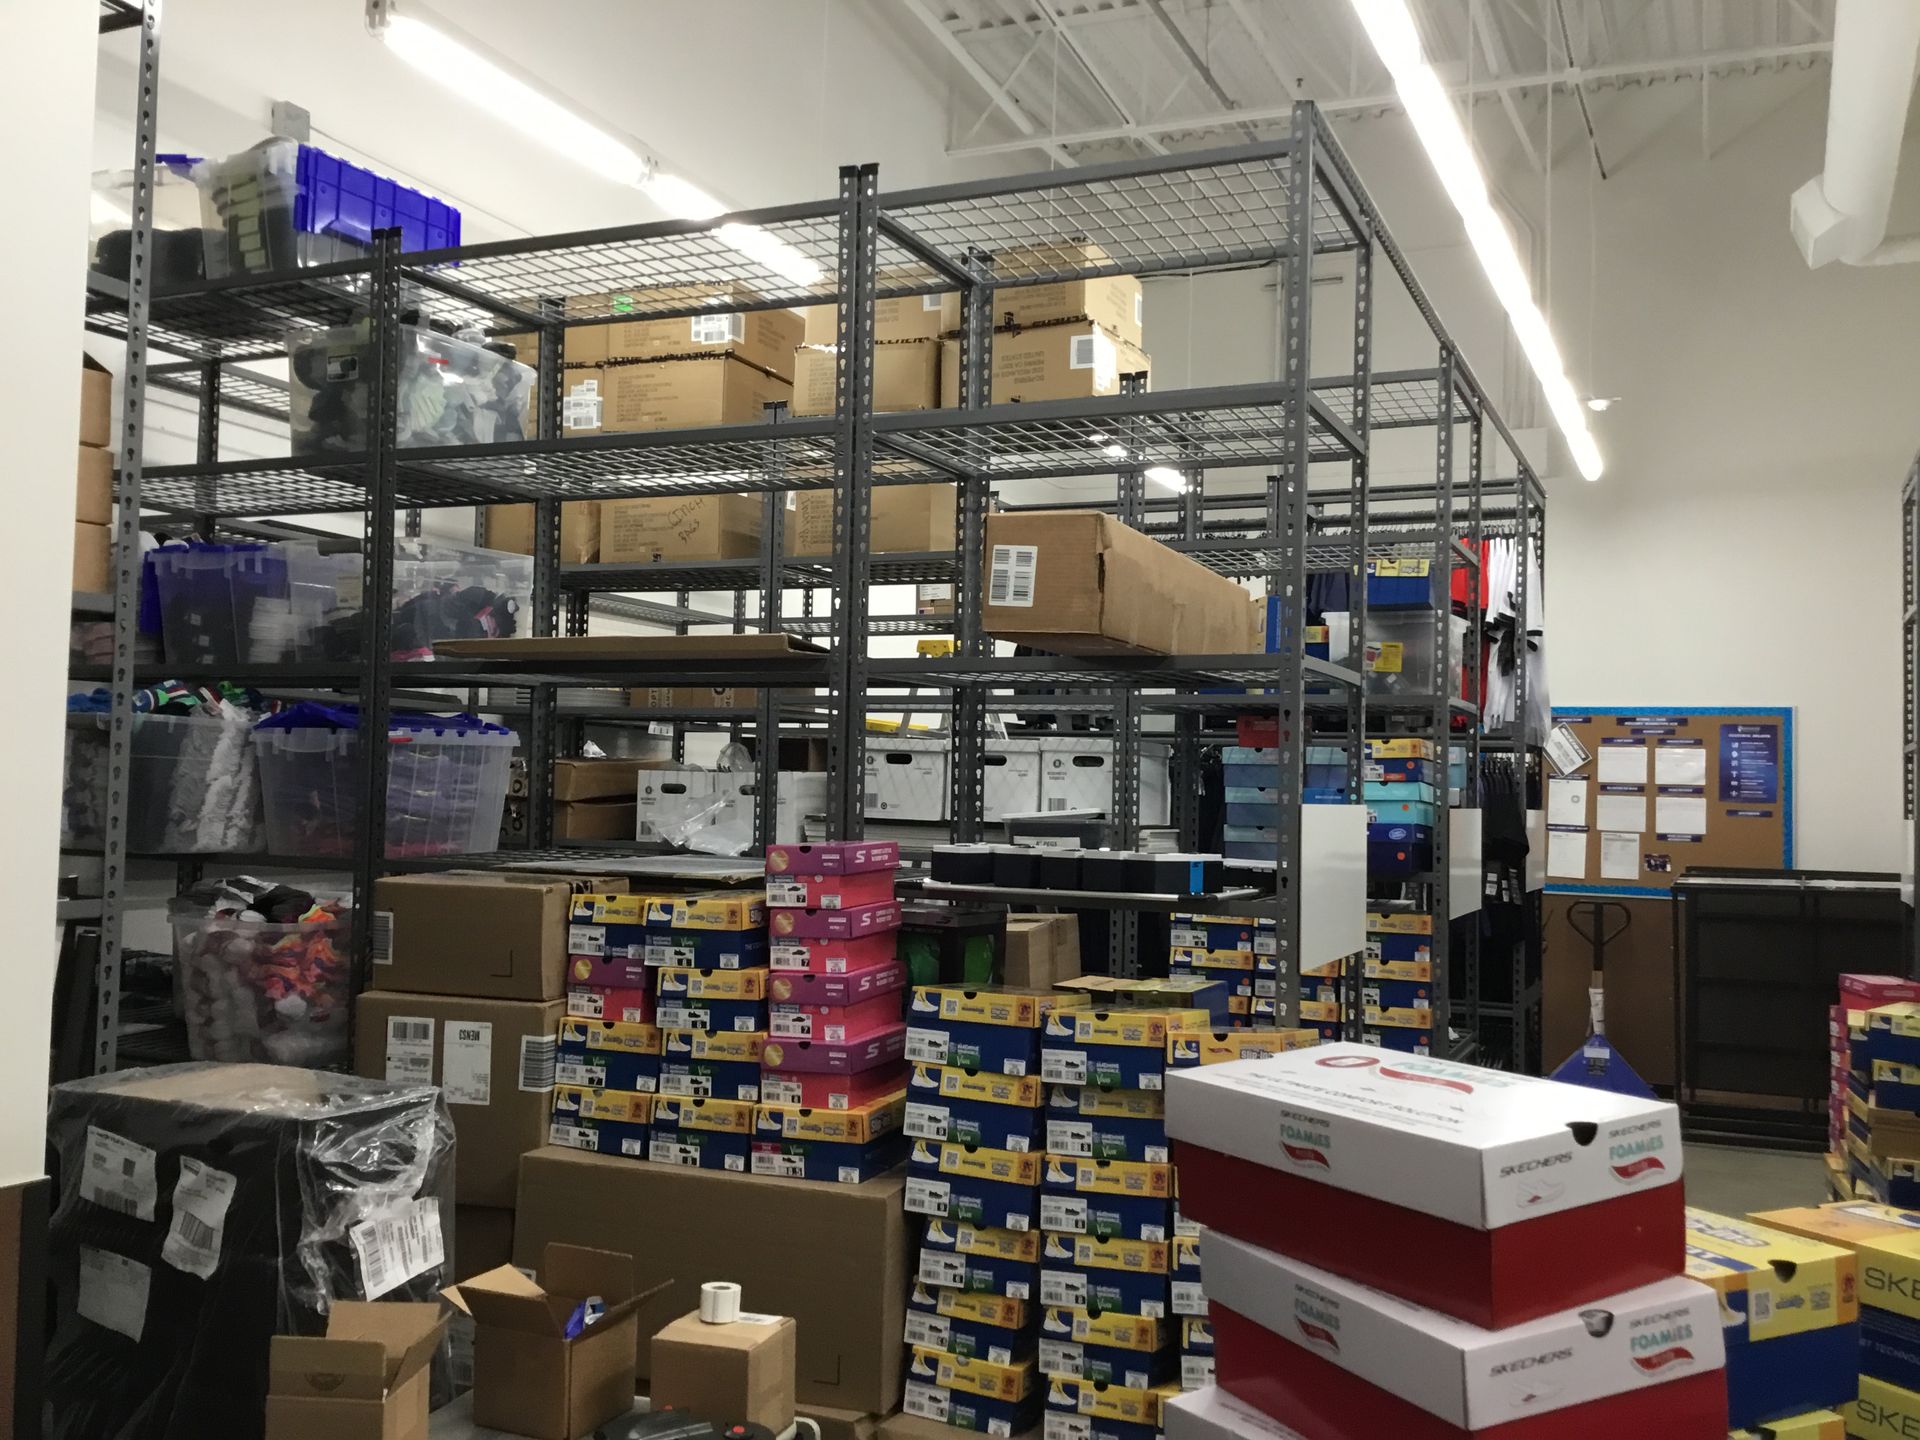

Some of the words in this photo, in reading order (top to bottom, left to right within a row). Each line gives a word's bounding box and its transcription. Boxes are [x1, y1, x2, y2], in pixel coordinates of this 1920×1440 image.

[1608, 1119, 1662, 1138] SKECHERS
[1499, 1151, 1573, 1178] SKECHERS
[1628, 1308, 1691, 1329] SKECHERS
[1488, 1348, 1573, 1378] SKECHERS
